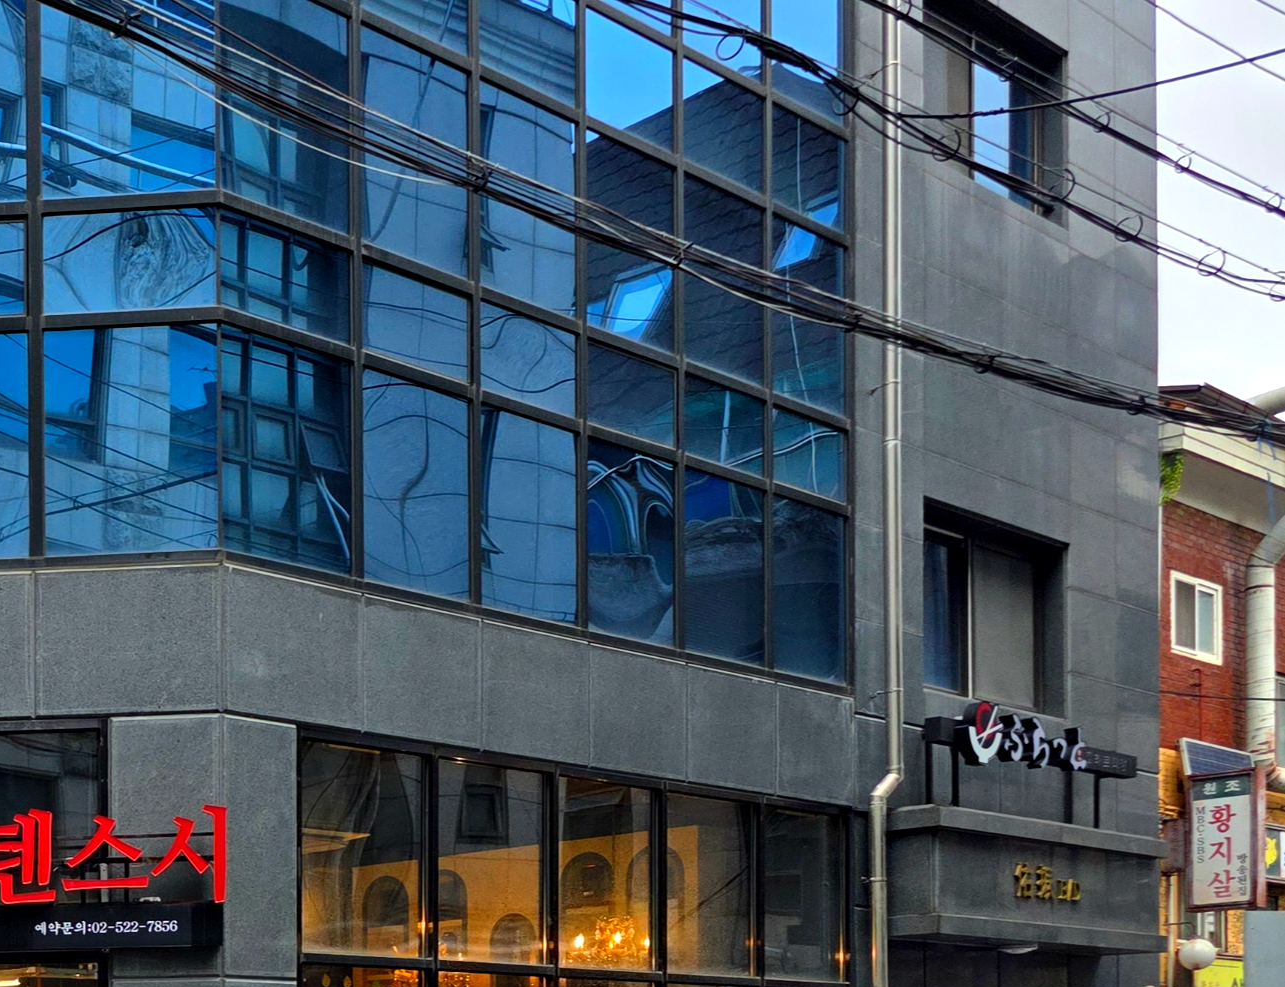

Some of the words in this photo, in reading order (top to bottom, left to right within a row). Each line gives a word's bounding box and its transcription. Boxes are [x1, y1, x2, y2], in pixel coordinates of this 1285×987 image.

[1202, 780, 1241, 796] 원조
[1207, 804, 1236, 898] 황지살
[34, 919, 179, 936] 예약문의:02-522-7856
